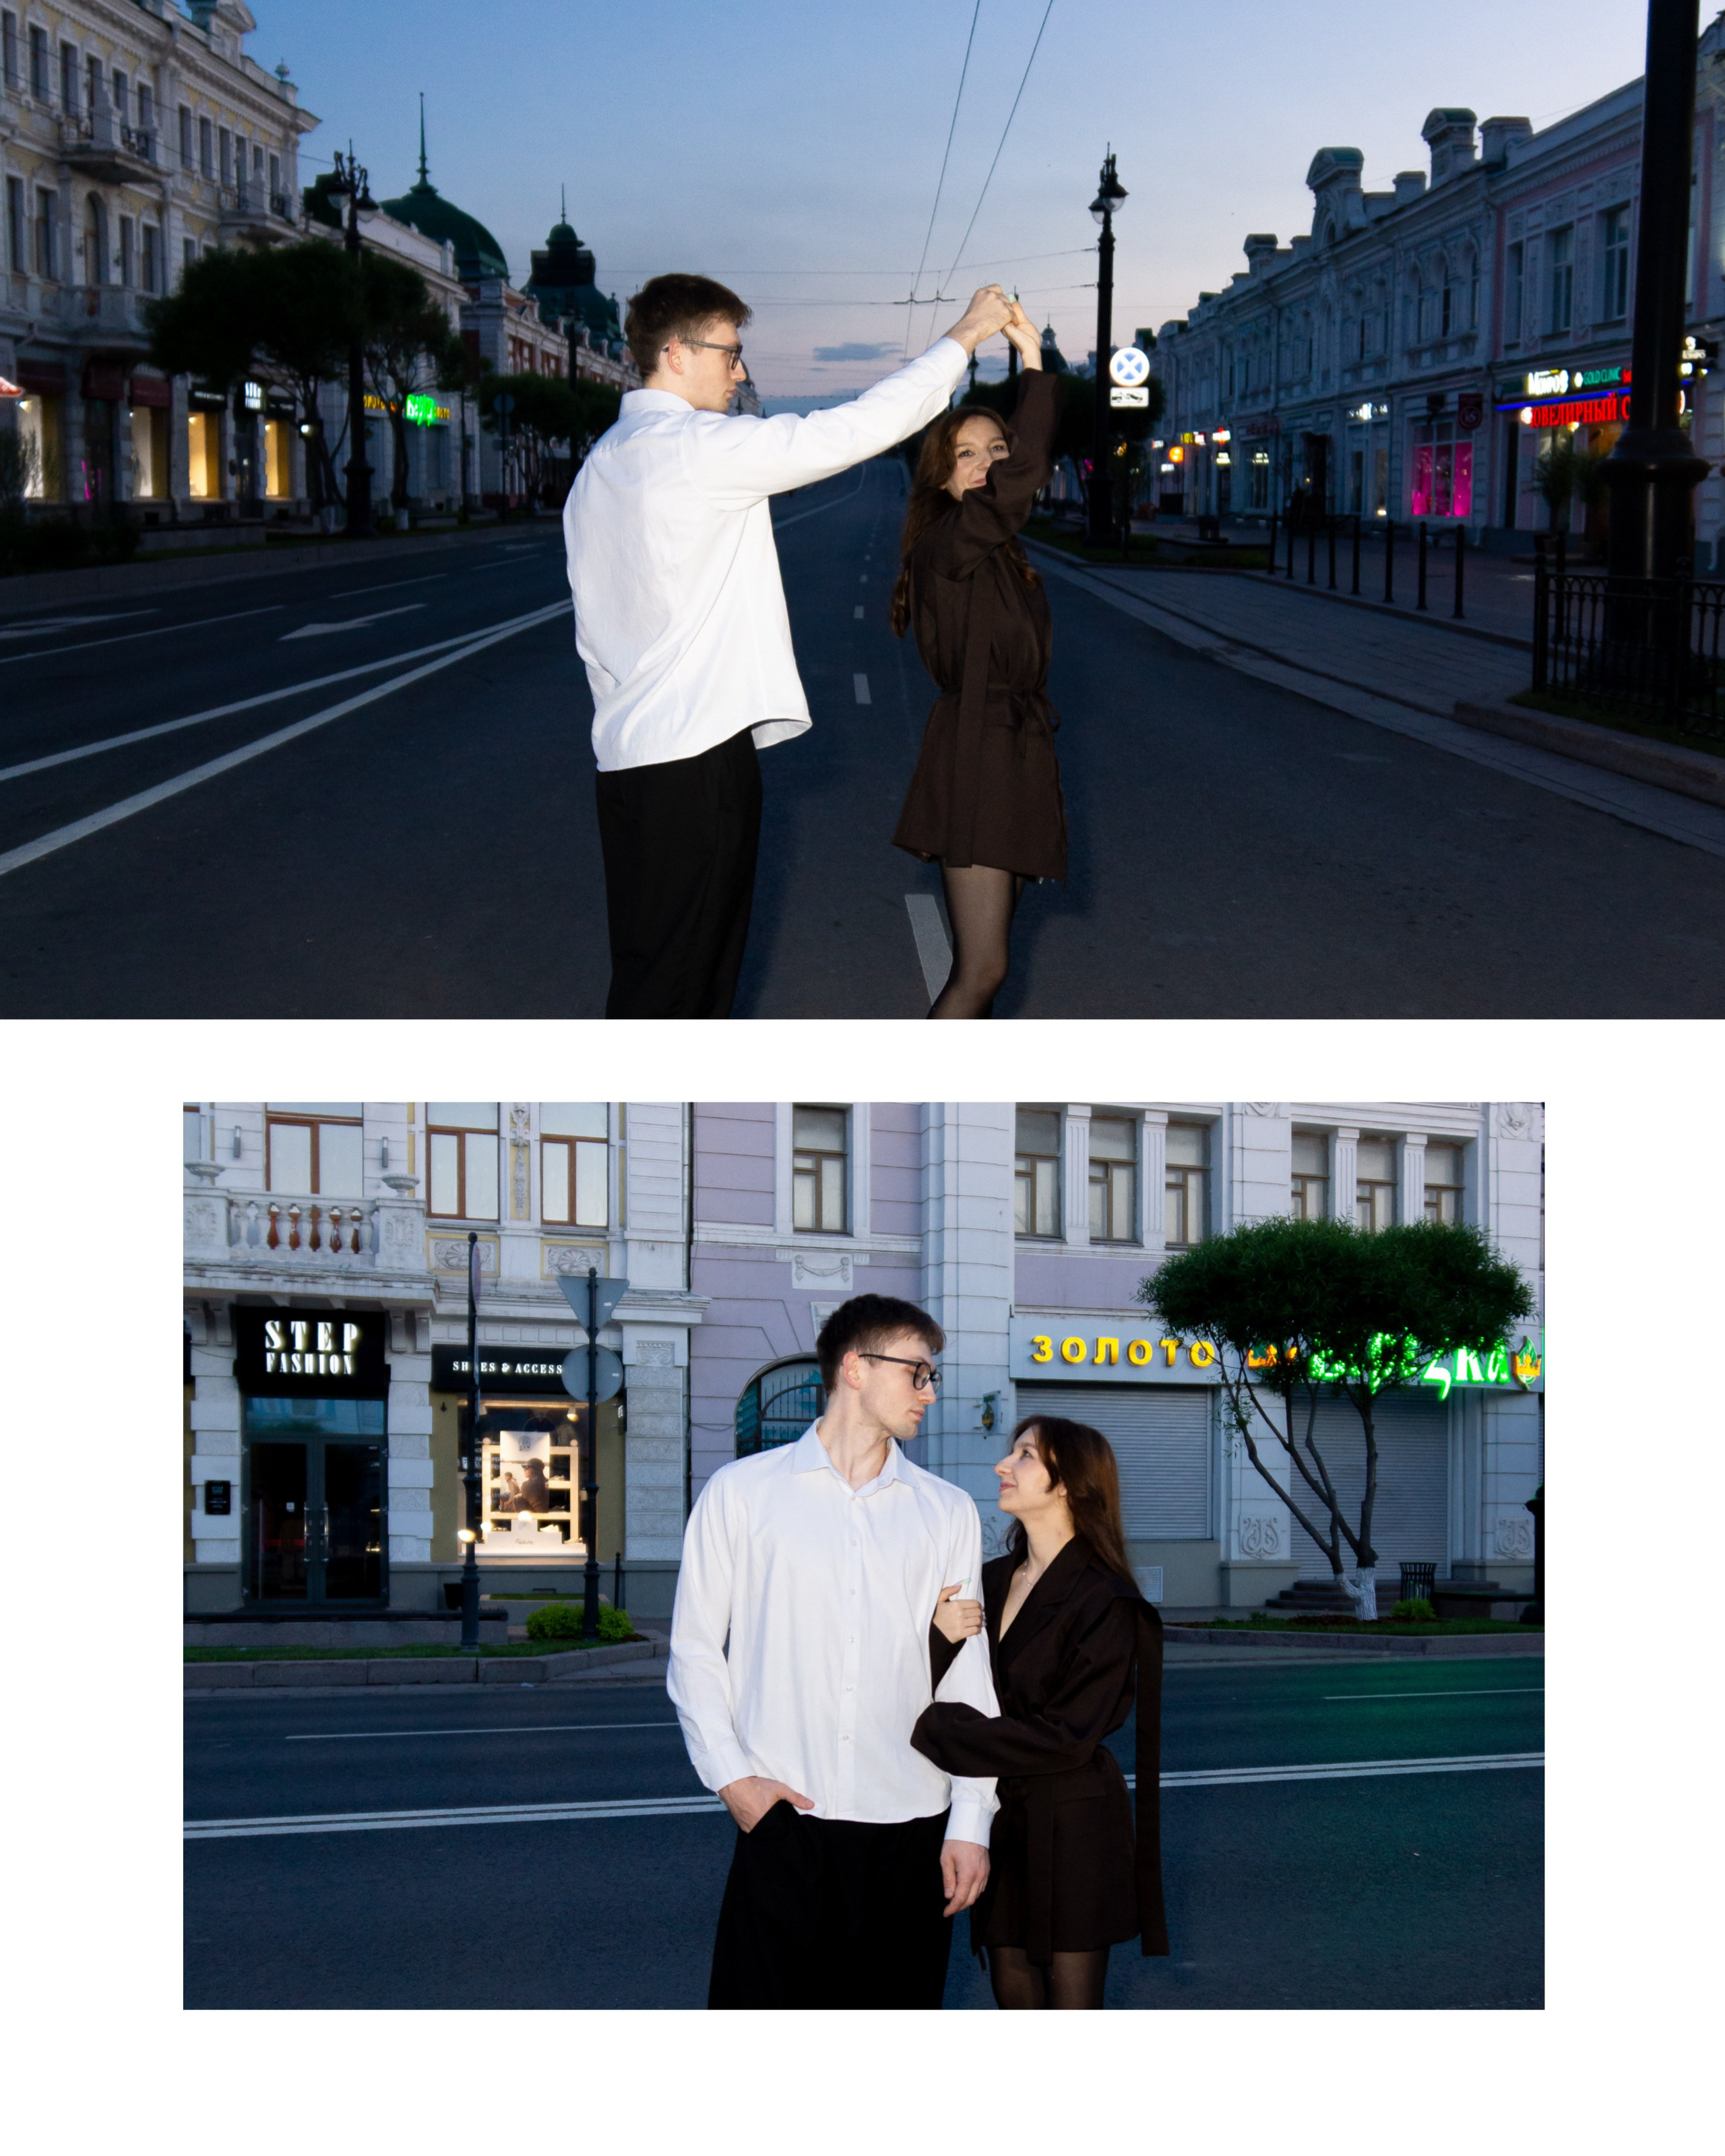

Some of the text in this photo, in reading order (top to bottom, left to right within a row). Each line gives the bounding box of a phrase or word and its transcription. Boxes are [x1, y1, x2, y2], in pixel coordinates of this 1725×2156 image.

[1583, 370, 1600, 385] GOLD
[265, 1320, 358, 1352] STEP
[1031, 1335, 1215, 1368] ЗОЛОТО
[266, 1352, 352, 1375] FASHION
[453, 1361, 495, 1372] SHES
[515, 1363, 563, 1374] ACCESS
